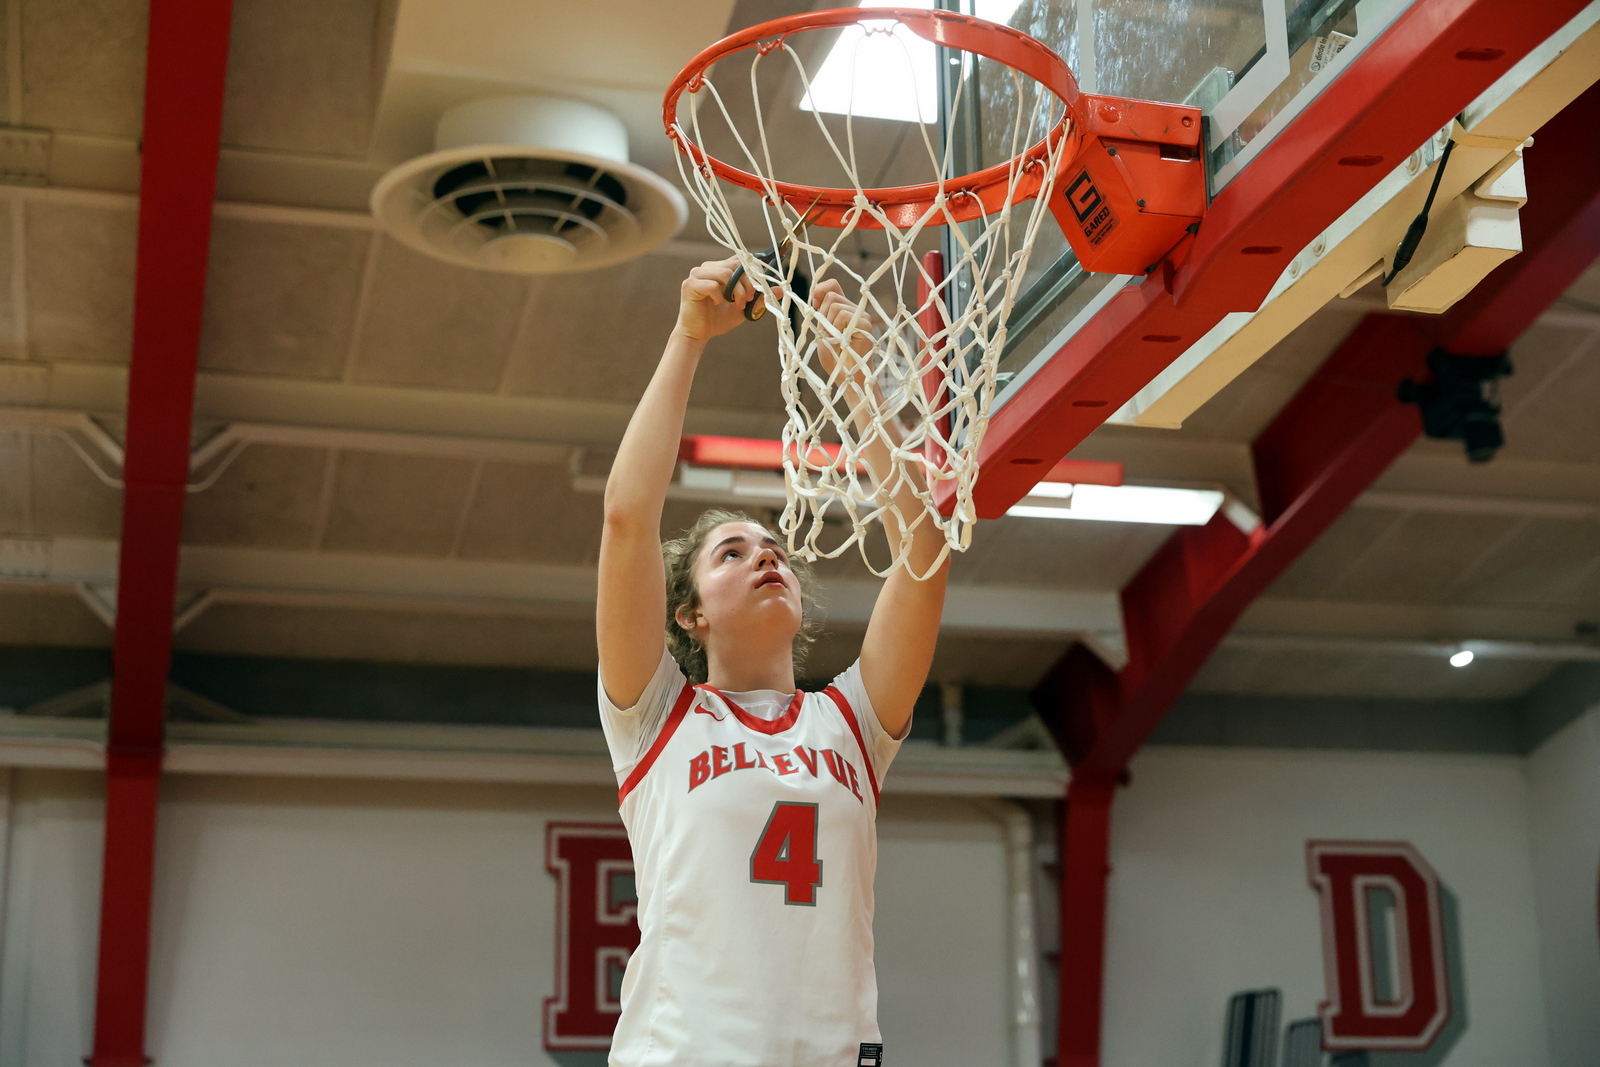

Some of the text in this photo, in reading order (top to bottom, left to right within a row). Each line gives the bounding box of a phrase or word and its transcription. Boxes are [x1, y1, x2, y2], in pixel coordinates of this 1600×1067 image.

[1083, 206, 1110, 238] GARED
[687, 741, 864, 806] BELLEVUE
[749, 800, 823, 907] 4
[1305, 839, 1451, 1051] D
